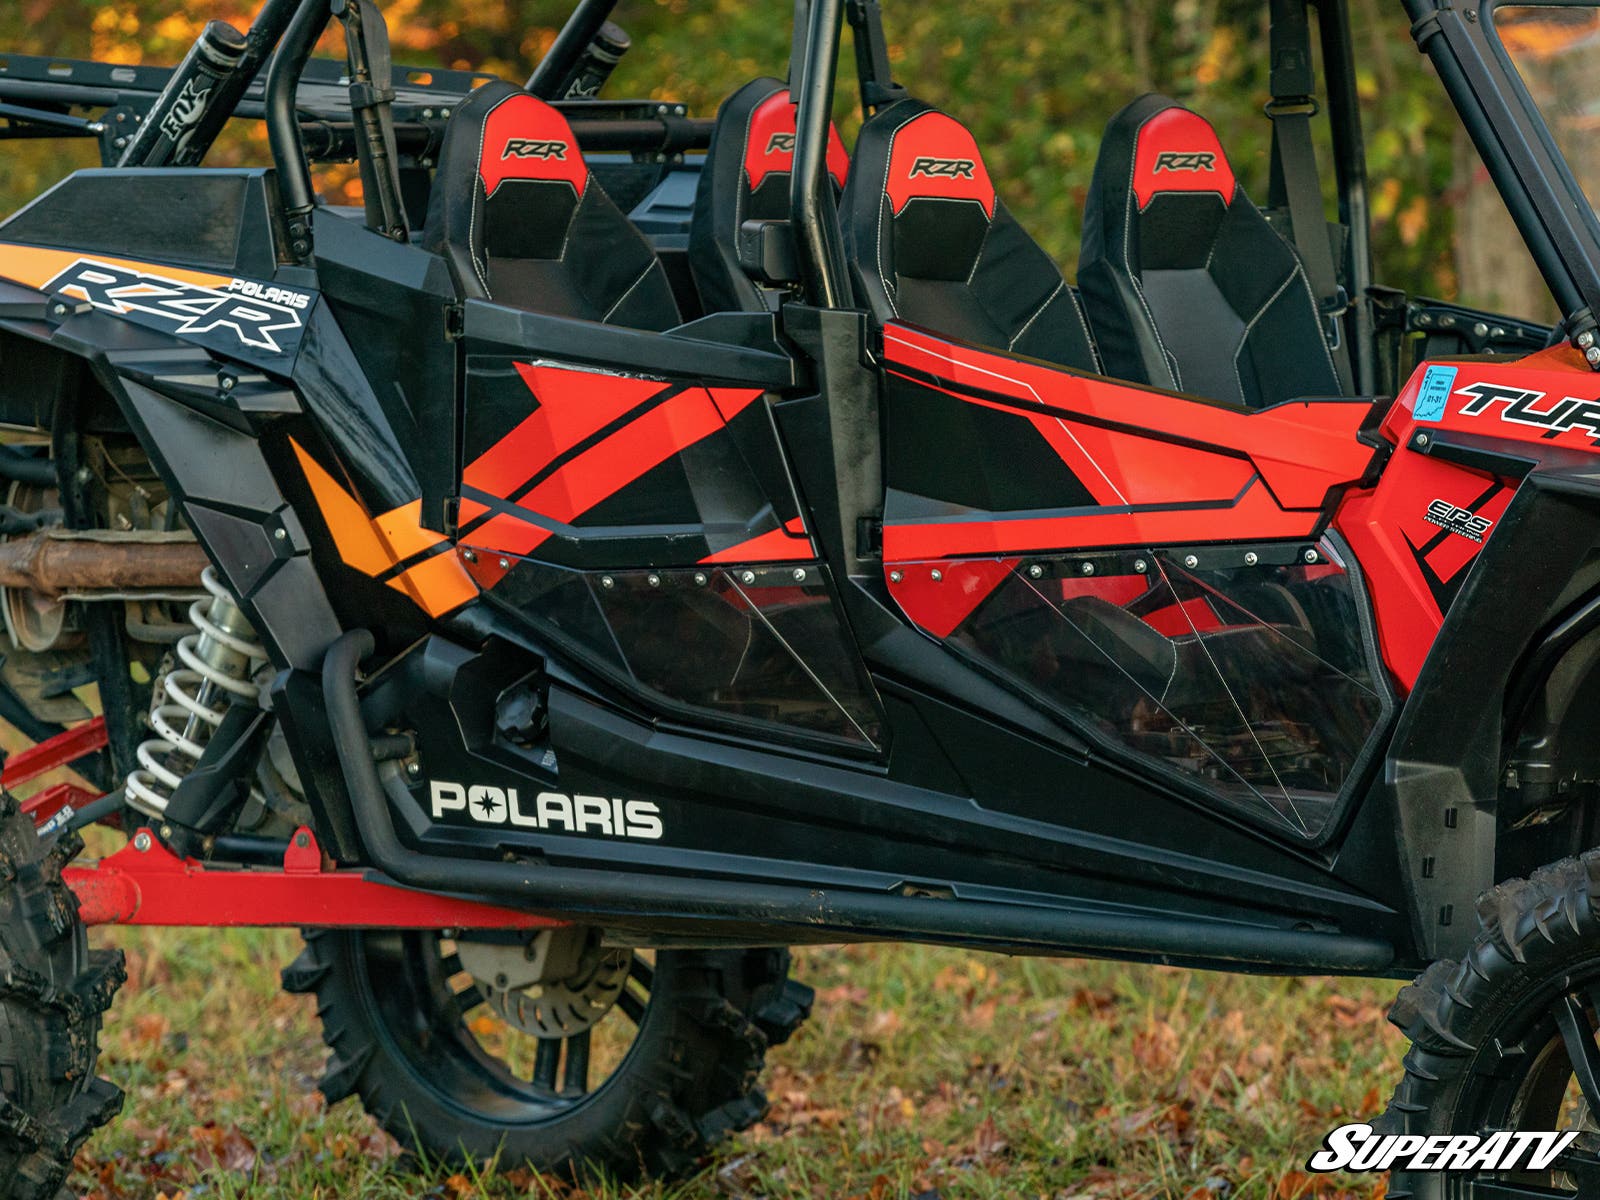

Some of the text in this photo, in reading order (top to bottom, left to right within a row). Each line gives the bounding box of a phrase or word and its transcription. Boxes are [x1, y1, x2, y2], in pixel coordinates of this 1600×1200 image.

[160, 78, 209, 141] FOX
[501, 138, 568, 161] RZR
[1153, 151, 1216, 174] RZR
[908, 156, 976, 179] RZR
[39, 258, 302, 352] RZR
[228, 278, 310, 309] POLARIS
[1427, 499, 1493, 533] EPS
[430, 780, 663, 839] POLARIS
